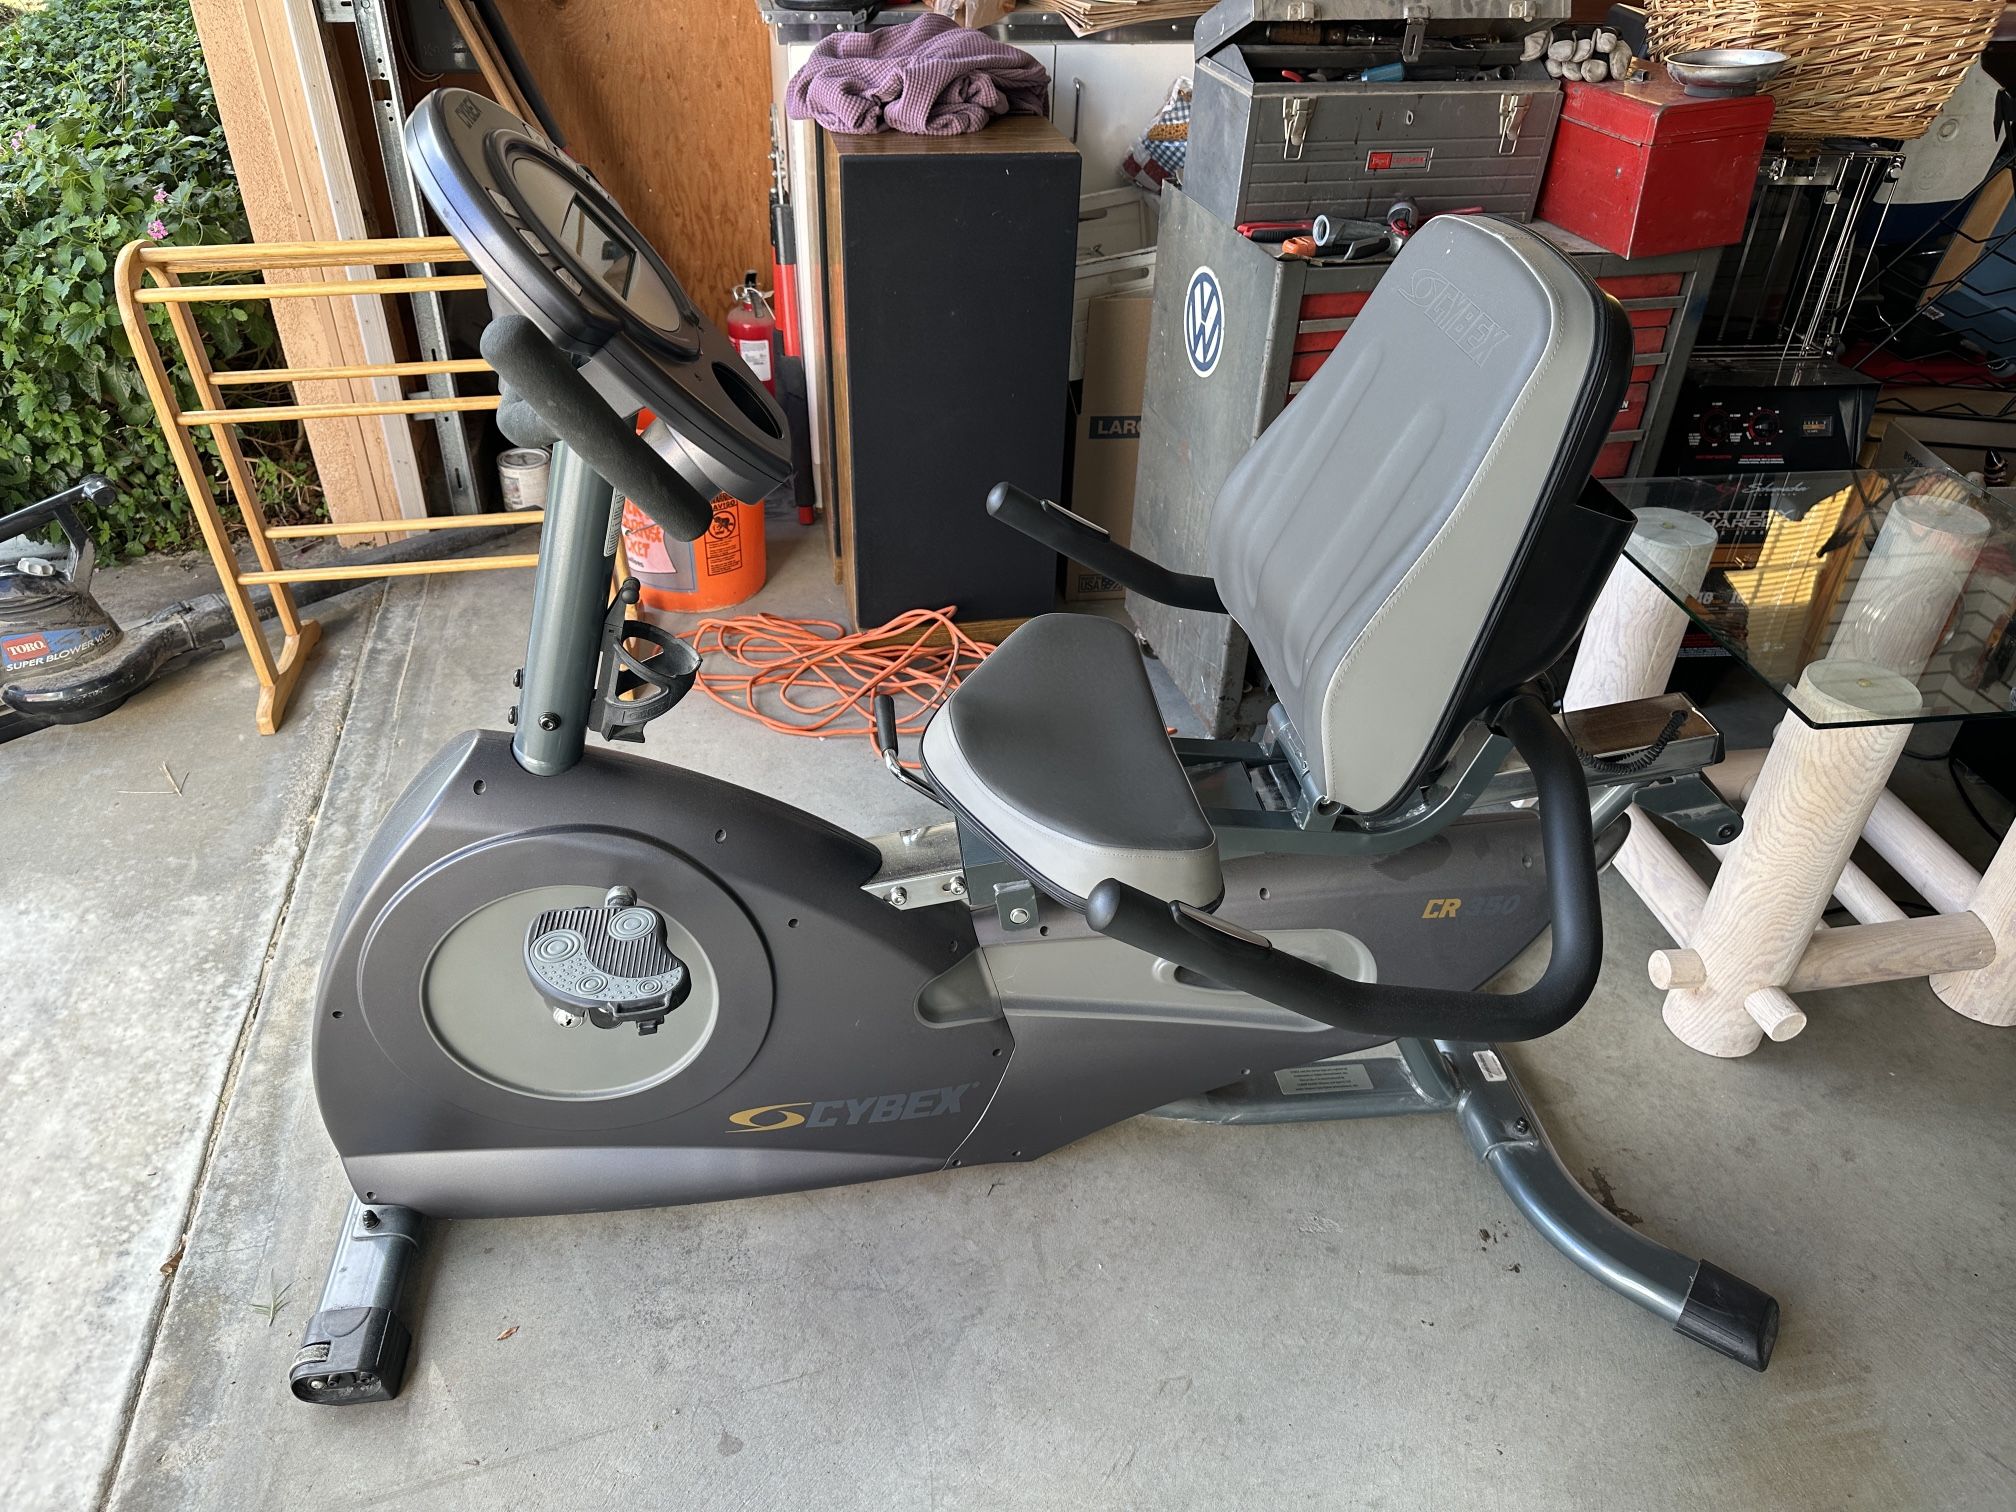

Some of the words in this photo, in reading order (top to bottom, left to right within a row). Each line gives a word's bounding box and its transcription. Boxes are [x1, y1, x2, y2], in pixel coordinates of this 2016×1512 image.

[1424, 282, 1511, 367] CYBEX
[1098, 420, 1140, 435] LAR
[6, 657, 44, 671] SUPER
[46, 641, 94, 663] BLOWER
[94, 627, 112, 642] VAC
[7, 640, 46, 656] TORO
[1422, 898, 1462, 919] CR
[805, 1083, 970, 1128] CYBEX
